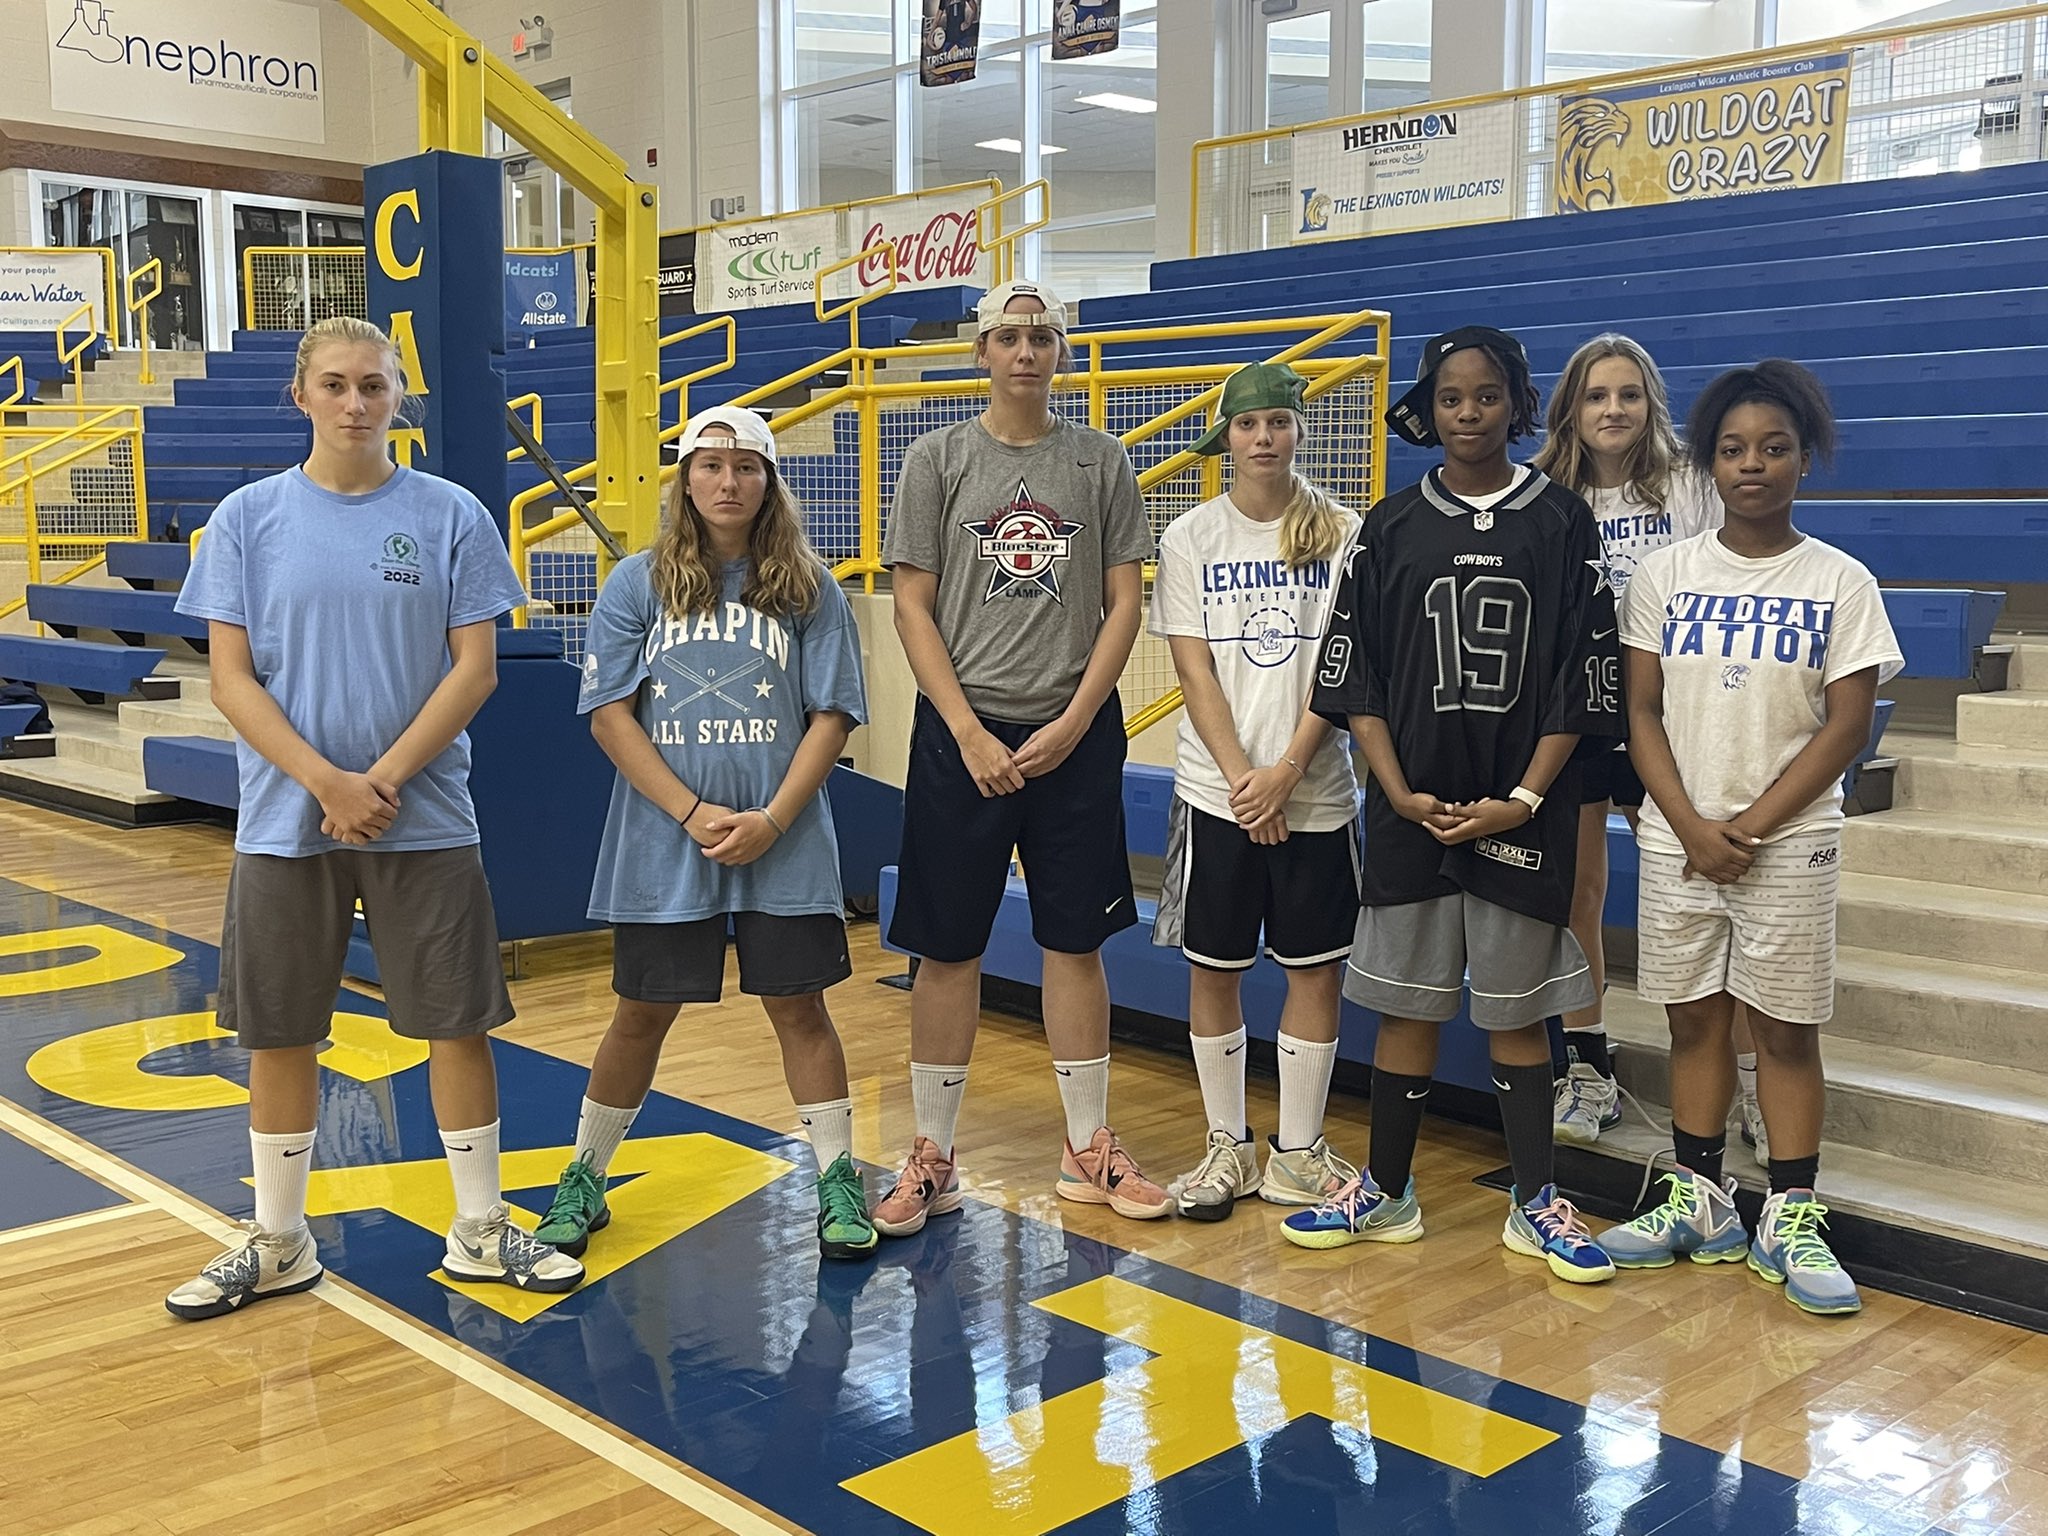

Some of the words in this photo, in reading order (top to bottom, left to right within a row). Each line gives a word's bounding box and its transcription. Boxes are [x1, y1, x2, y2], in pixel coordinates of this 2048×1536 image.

[125, 35, 318, 92] nephron
[195, 77, 268, 95] pharmaceuticals
[269, 87, 319, 101] corporation
[1659, 79, 1697, 94] Lexington
[1697, 75, 1728, 88] Wildcat
[1728, 70, 1760, 83] Athletic
[1762, 65, 1792, 78] Booster
[1794, 61, 1815, 72] Club
[1646, 77, 1845, 148] WILDCAT
[1374, 142, 1423, 155] CHEVROLET
[1389, 156, 1401, 165] YOU
[1666, 132, 1829, 193] CRAZY
[1333, 196, 1362, 215] THE
[1359, 187, 1431, 211] LEXINGTON
[1433, 178, 1505, 203] WILDCATS!
[728, 231, 779, 248] modern
[858, 208, 977, 288] Coca-Cola
[2, 267, 22, 275] your
[25, 265, 57, 276] people
[780, 246, 821, 273] turf
[657, 271, 685, 285] GUARD
[727, 286, 757, 300] Sports
[760, 281, 778, 296] Turf
[778, 278, 815, 293] Service
[30, 283, 87, 302] Water
[520, 312, 567, 326] Allstate
[991, 541, 1059, 553] BlueStar
[1453, 554, 1503, 567] COWBOYS
[383, 570, 421, 586] 2022
[1203, 559, 1331, 593] LEXINGTON
[1005, 588, 1043, 599] CAMP
[1668, 593, 1833, 632] WILDCAT
[645, 601, 790, 672] CHAPIN
[1424, 575, 1533, 714] 19
[1661, 622, 1829, 671] NATION
[1318, 634, 1353, 689] 9
[652, 720, 685, 745] ALL
[698, 718, 778, 744] STARS
[1502, 845, 1524, 859] XXL
